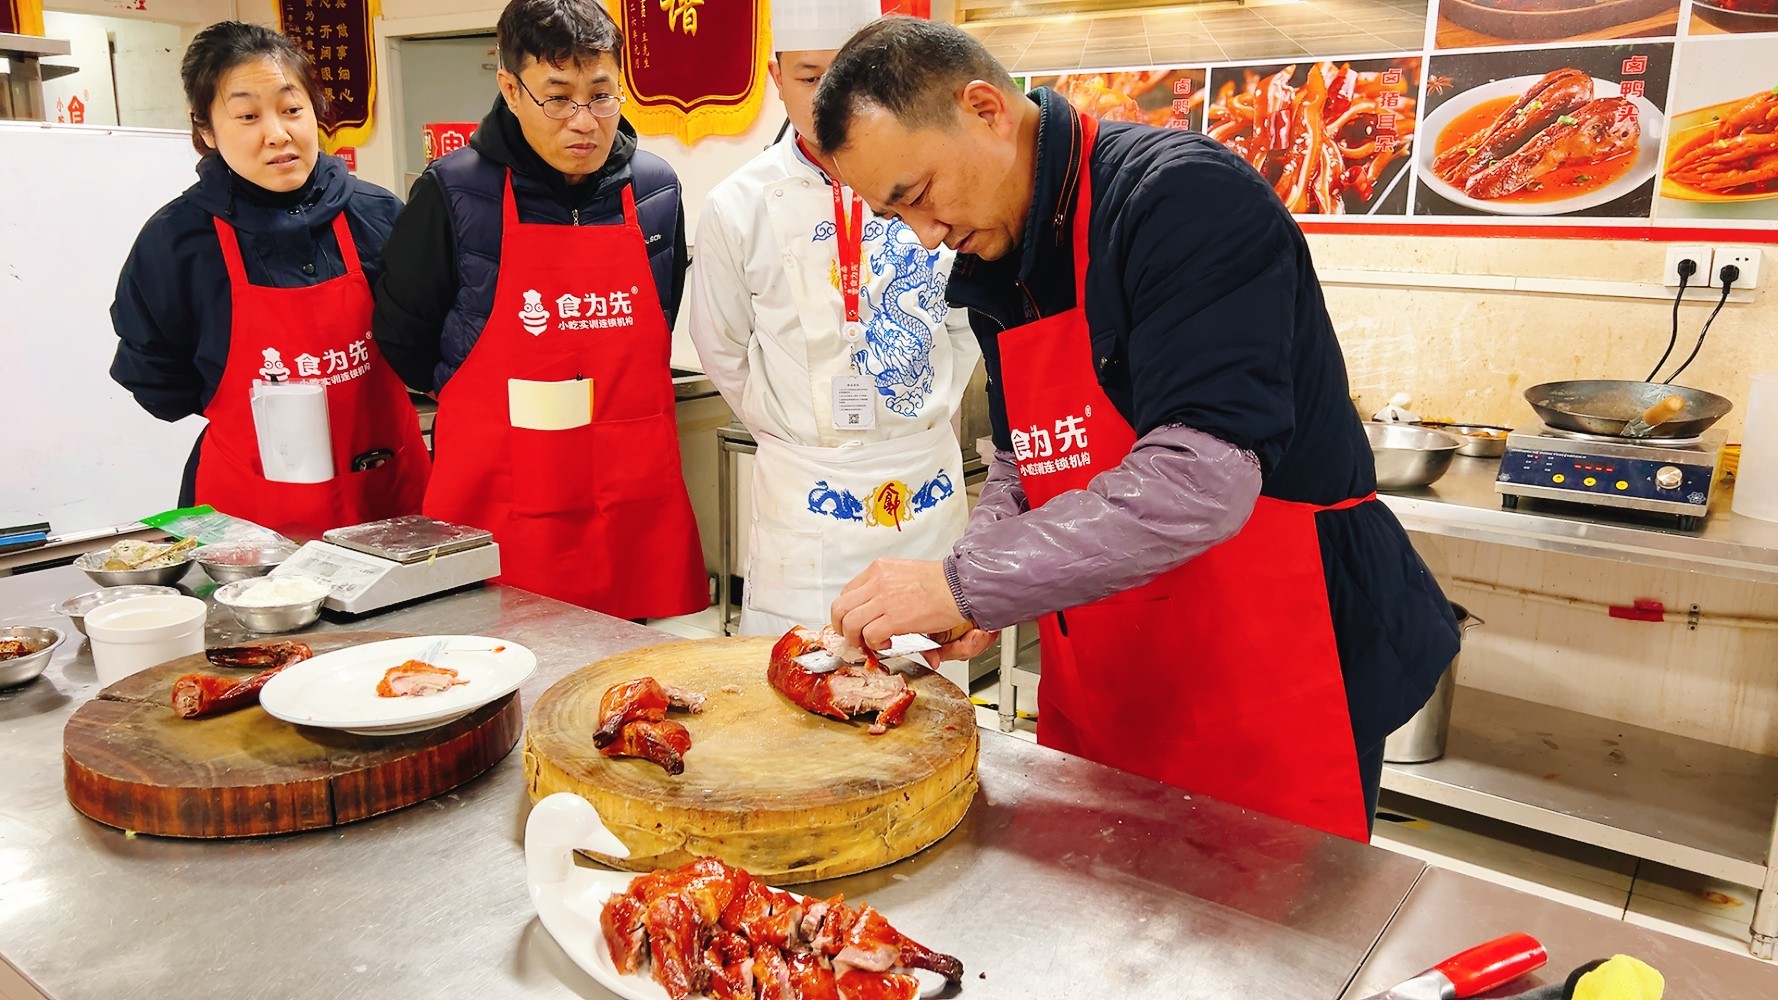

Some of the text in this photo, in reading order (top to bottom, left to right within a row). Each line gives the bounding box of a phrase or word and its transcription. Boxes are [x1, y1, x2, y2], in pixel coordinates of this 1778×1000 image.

[1374, 67, 1403, 153] 卤猪耳朵
[1617, 55, 1648, 124] 卤鸭头
[554, 290, 633, 319] 食为先
[557, 315, 634, 331] 小吃实训连锁机构
[293, 338, 370, 377] 食为先
[1010, 414, 1089, 462] 食为先
